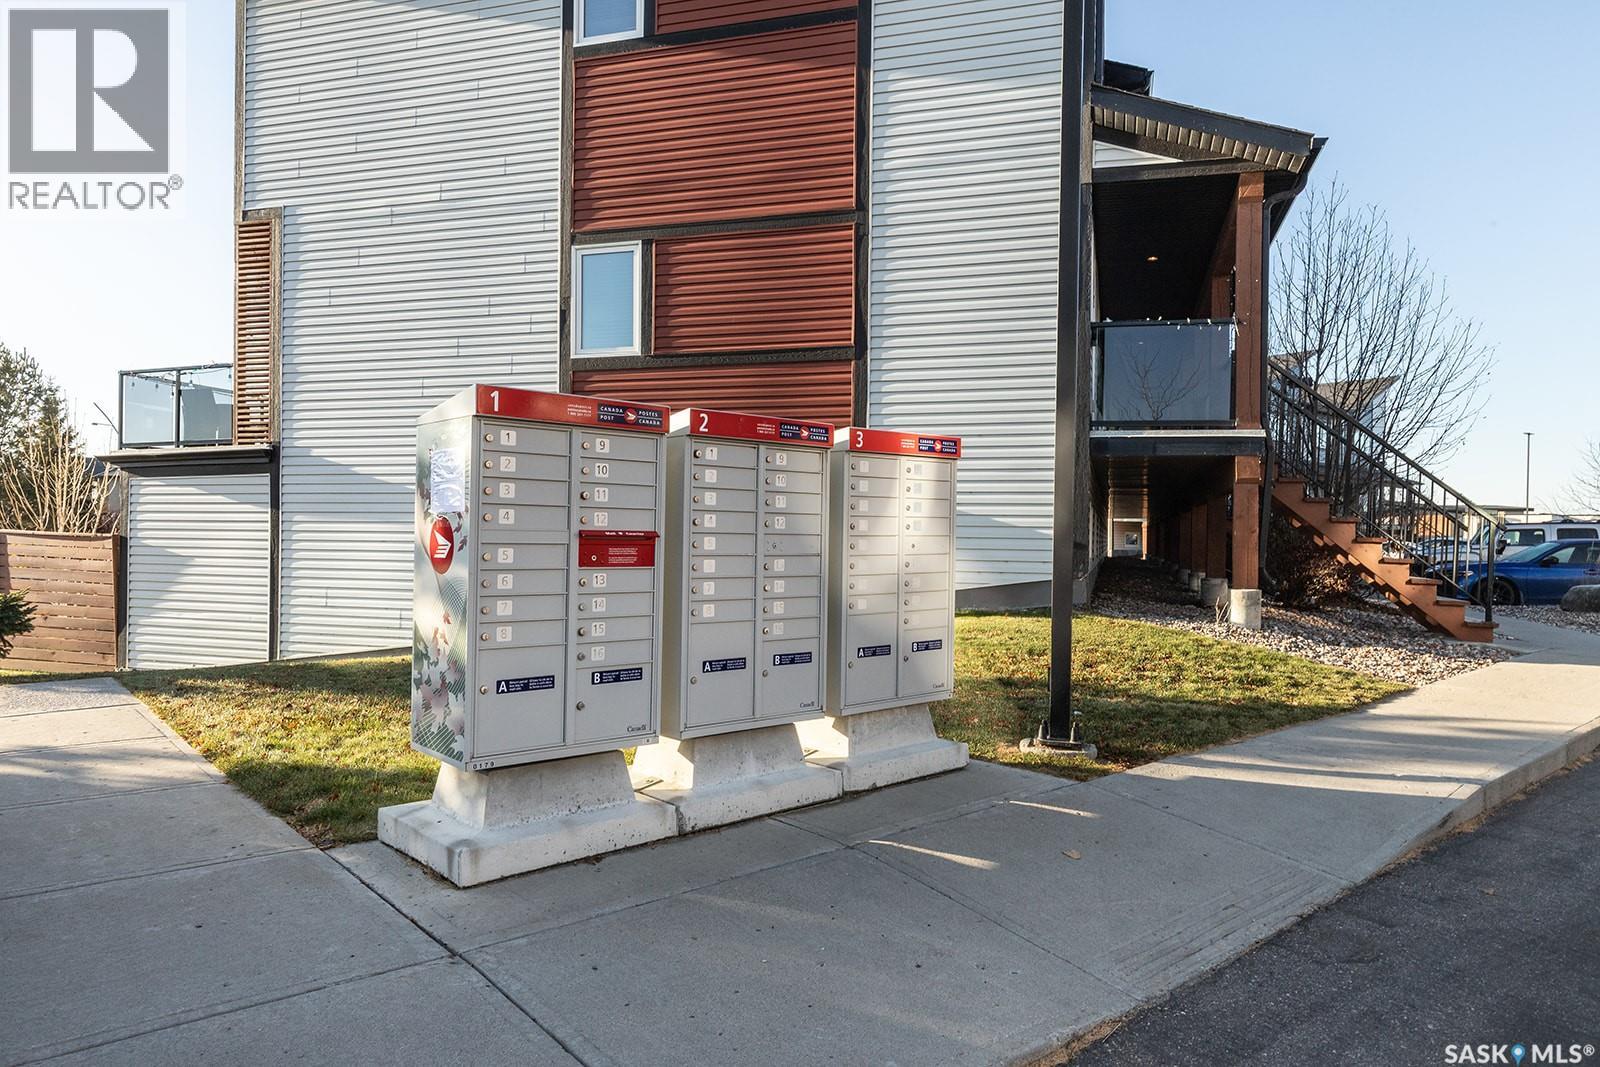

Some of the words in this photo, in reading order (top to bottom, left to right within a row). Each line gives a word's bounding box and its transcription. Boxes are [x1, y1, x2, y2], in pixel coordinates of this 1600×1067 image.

[490, 390, 499, 412] 1
[699, 413, 709, 432] 2
[856, 431, 863, 448] 3
[599, 440, 606, 450] 9
[504, 458, 511, 469] 2
[778, 454, 785, 464] 9
[597, 465, 608, 475] 10
[777, 476, 786, 485] 10
[503, 485, 510, 495] 3
[596, 490, 606, 499] 11
[503, 511, 510, 521] 4
[596, 514, 607, 525] 12
[776, 518, 785, 527] 12
[502, 550, 508, 560] 5
[501, 576, 508, 586] 6
[594, 575, 605, 585] 13
[500, 602, 508, 612] 7
[500, 628, 508, 639] 8
[593, 624, 604, 634] 15
[913, 643, 918, 651] B
[859, 649, 864, 657] A
[775, 655, 780, 665] B
[704, 661, 711, 672] A
[594, 672, 601, 683] B
[498, 681, 508, 693] A
